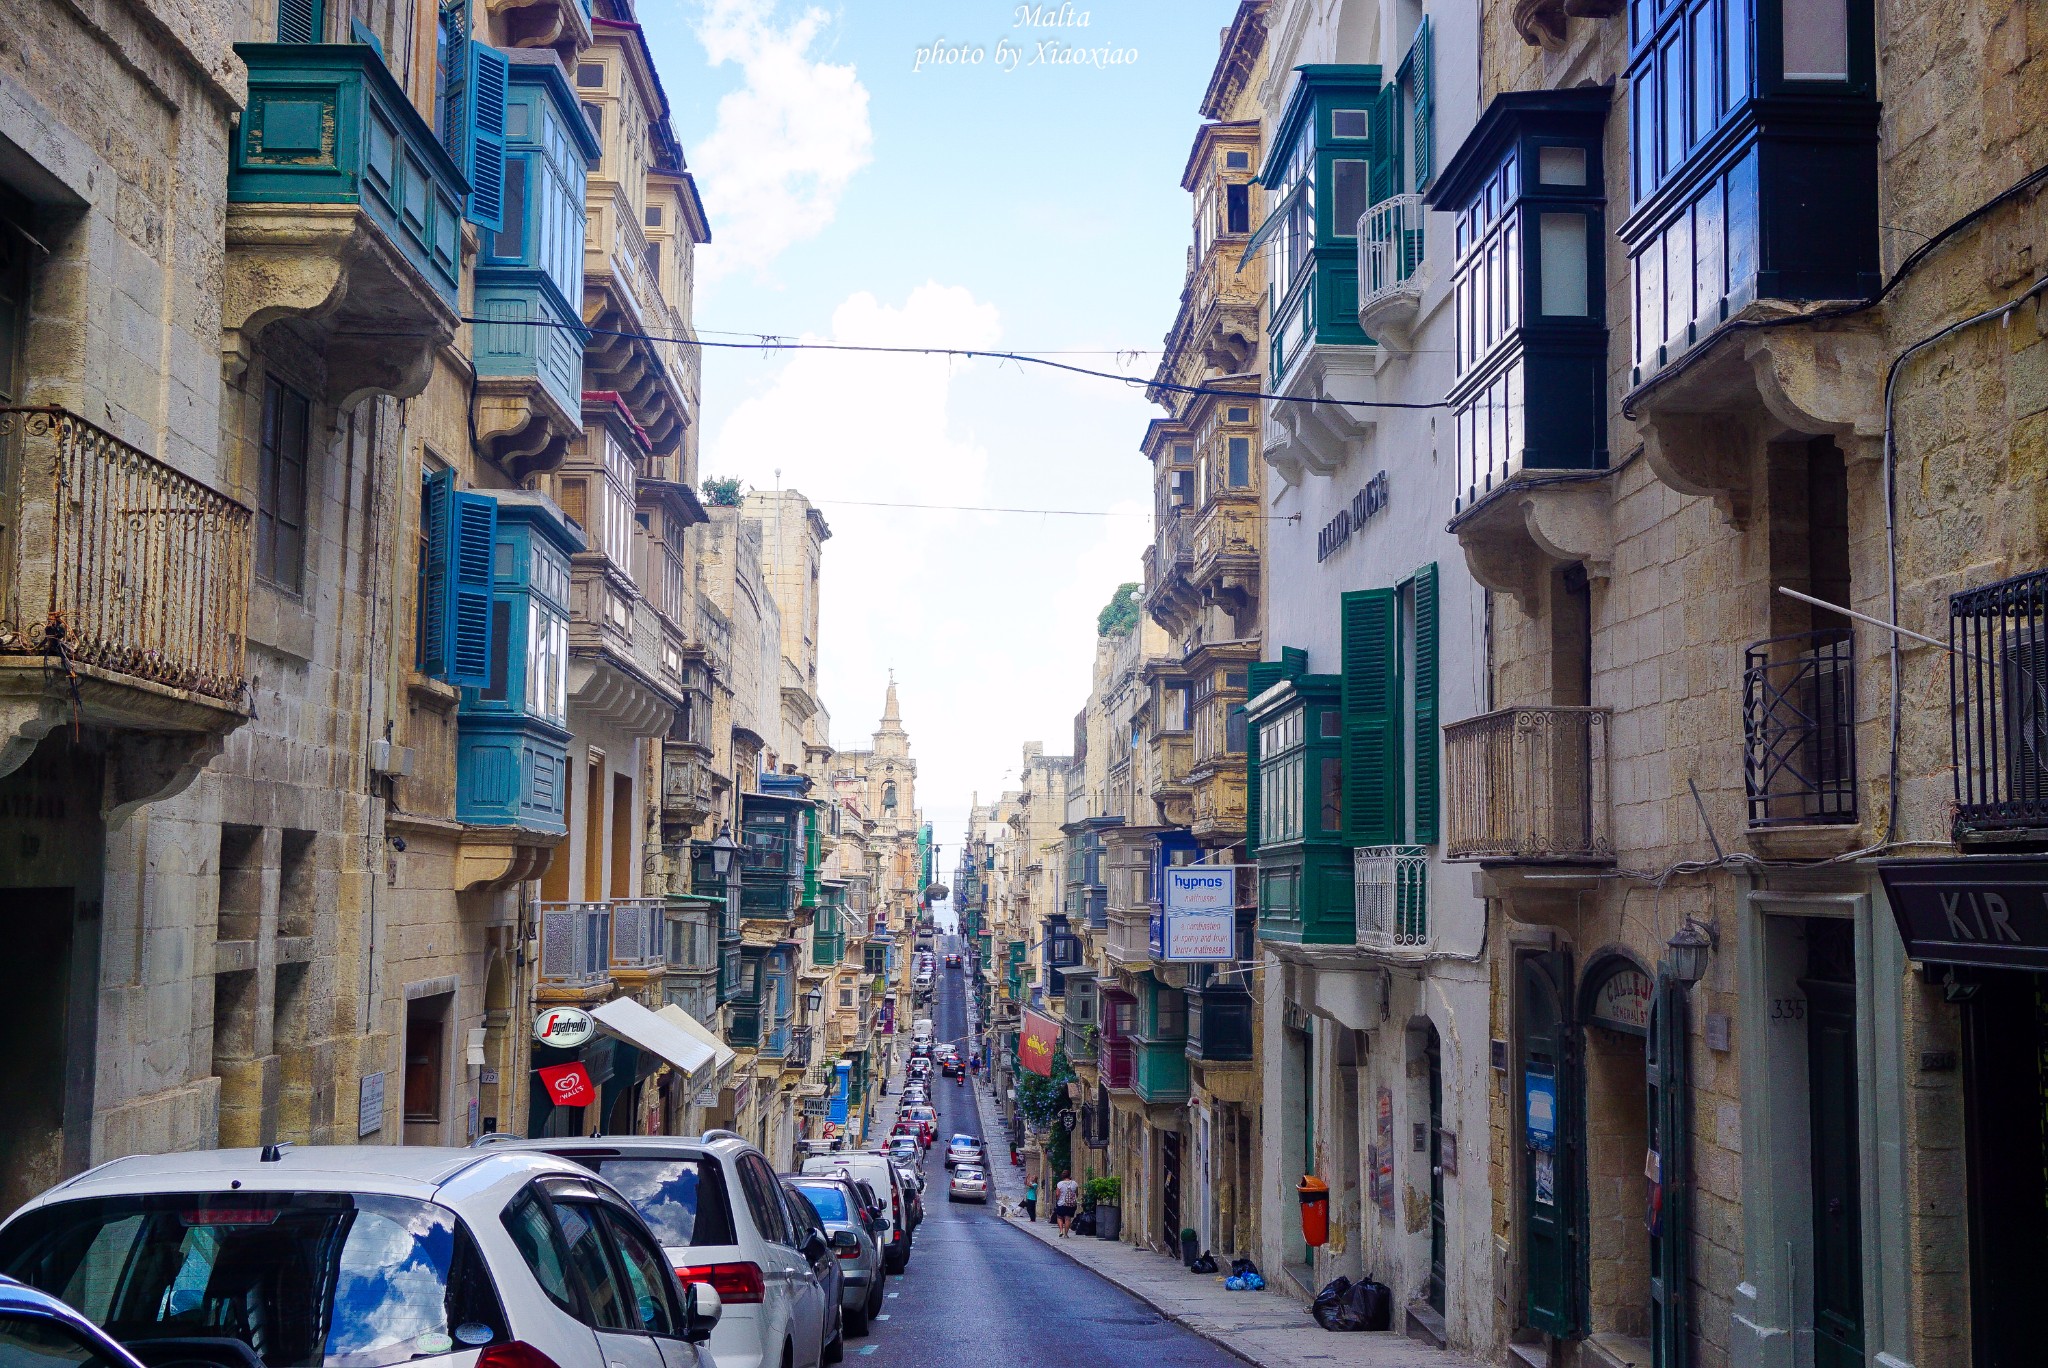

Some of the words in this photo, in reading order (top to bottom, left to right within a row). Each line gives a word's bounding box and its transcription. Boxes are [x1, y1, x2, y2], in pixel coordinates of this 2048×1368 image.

[1175, 874, 1223, 890] hypnos
[1940, 892, 2021, 942] KIR
[1612, 1005, 1638, 1022] GENERAL
[1771, 999, 1806, 1020] 335
[541, 1014, 587, 1038] Segafredo
[485, 1074, 495, 1082] 19
[561, 1084, 584, 1100] WALL'S
